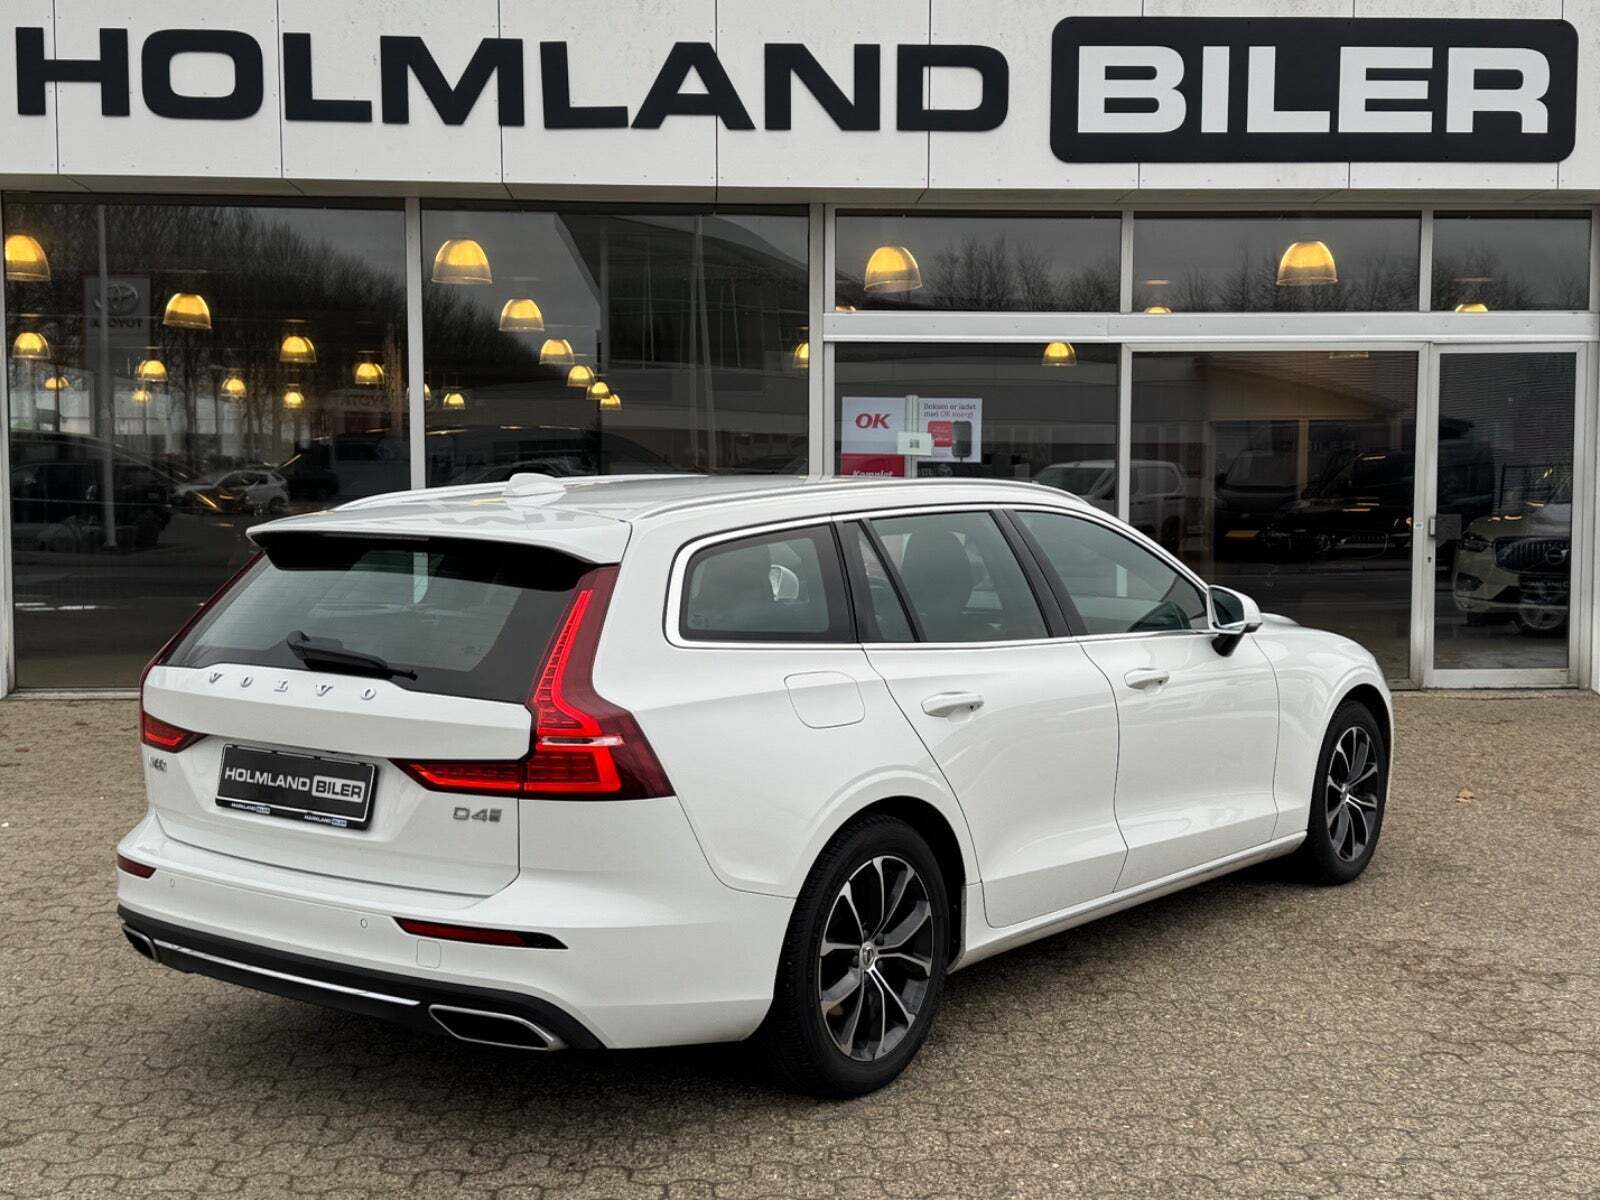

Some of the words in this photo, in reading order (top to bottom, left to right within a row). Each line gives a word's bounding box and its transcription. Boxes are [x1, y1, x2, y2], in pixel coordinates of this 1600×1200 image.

[15, 27, 1008, 131] HOLMLAND
[1077, 45, 1551, 135] BILER
[855, 413, 892, 429] OK
[209, 672, 377, 700] VOLVO
[224, 766, 311, 792] HOLMLAND
[315, 779, 363, 800] BILER
